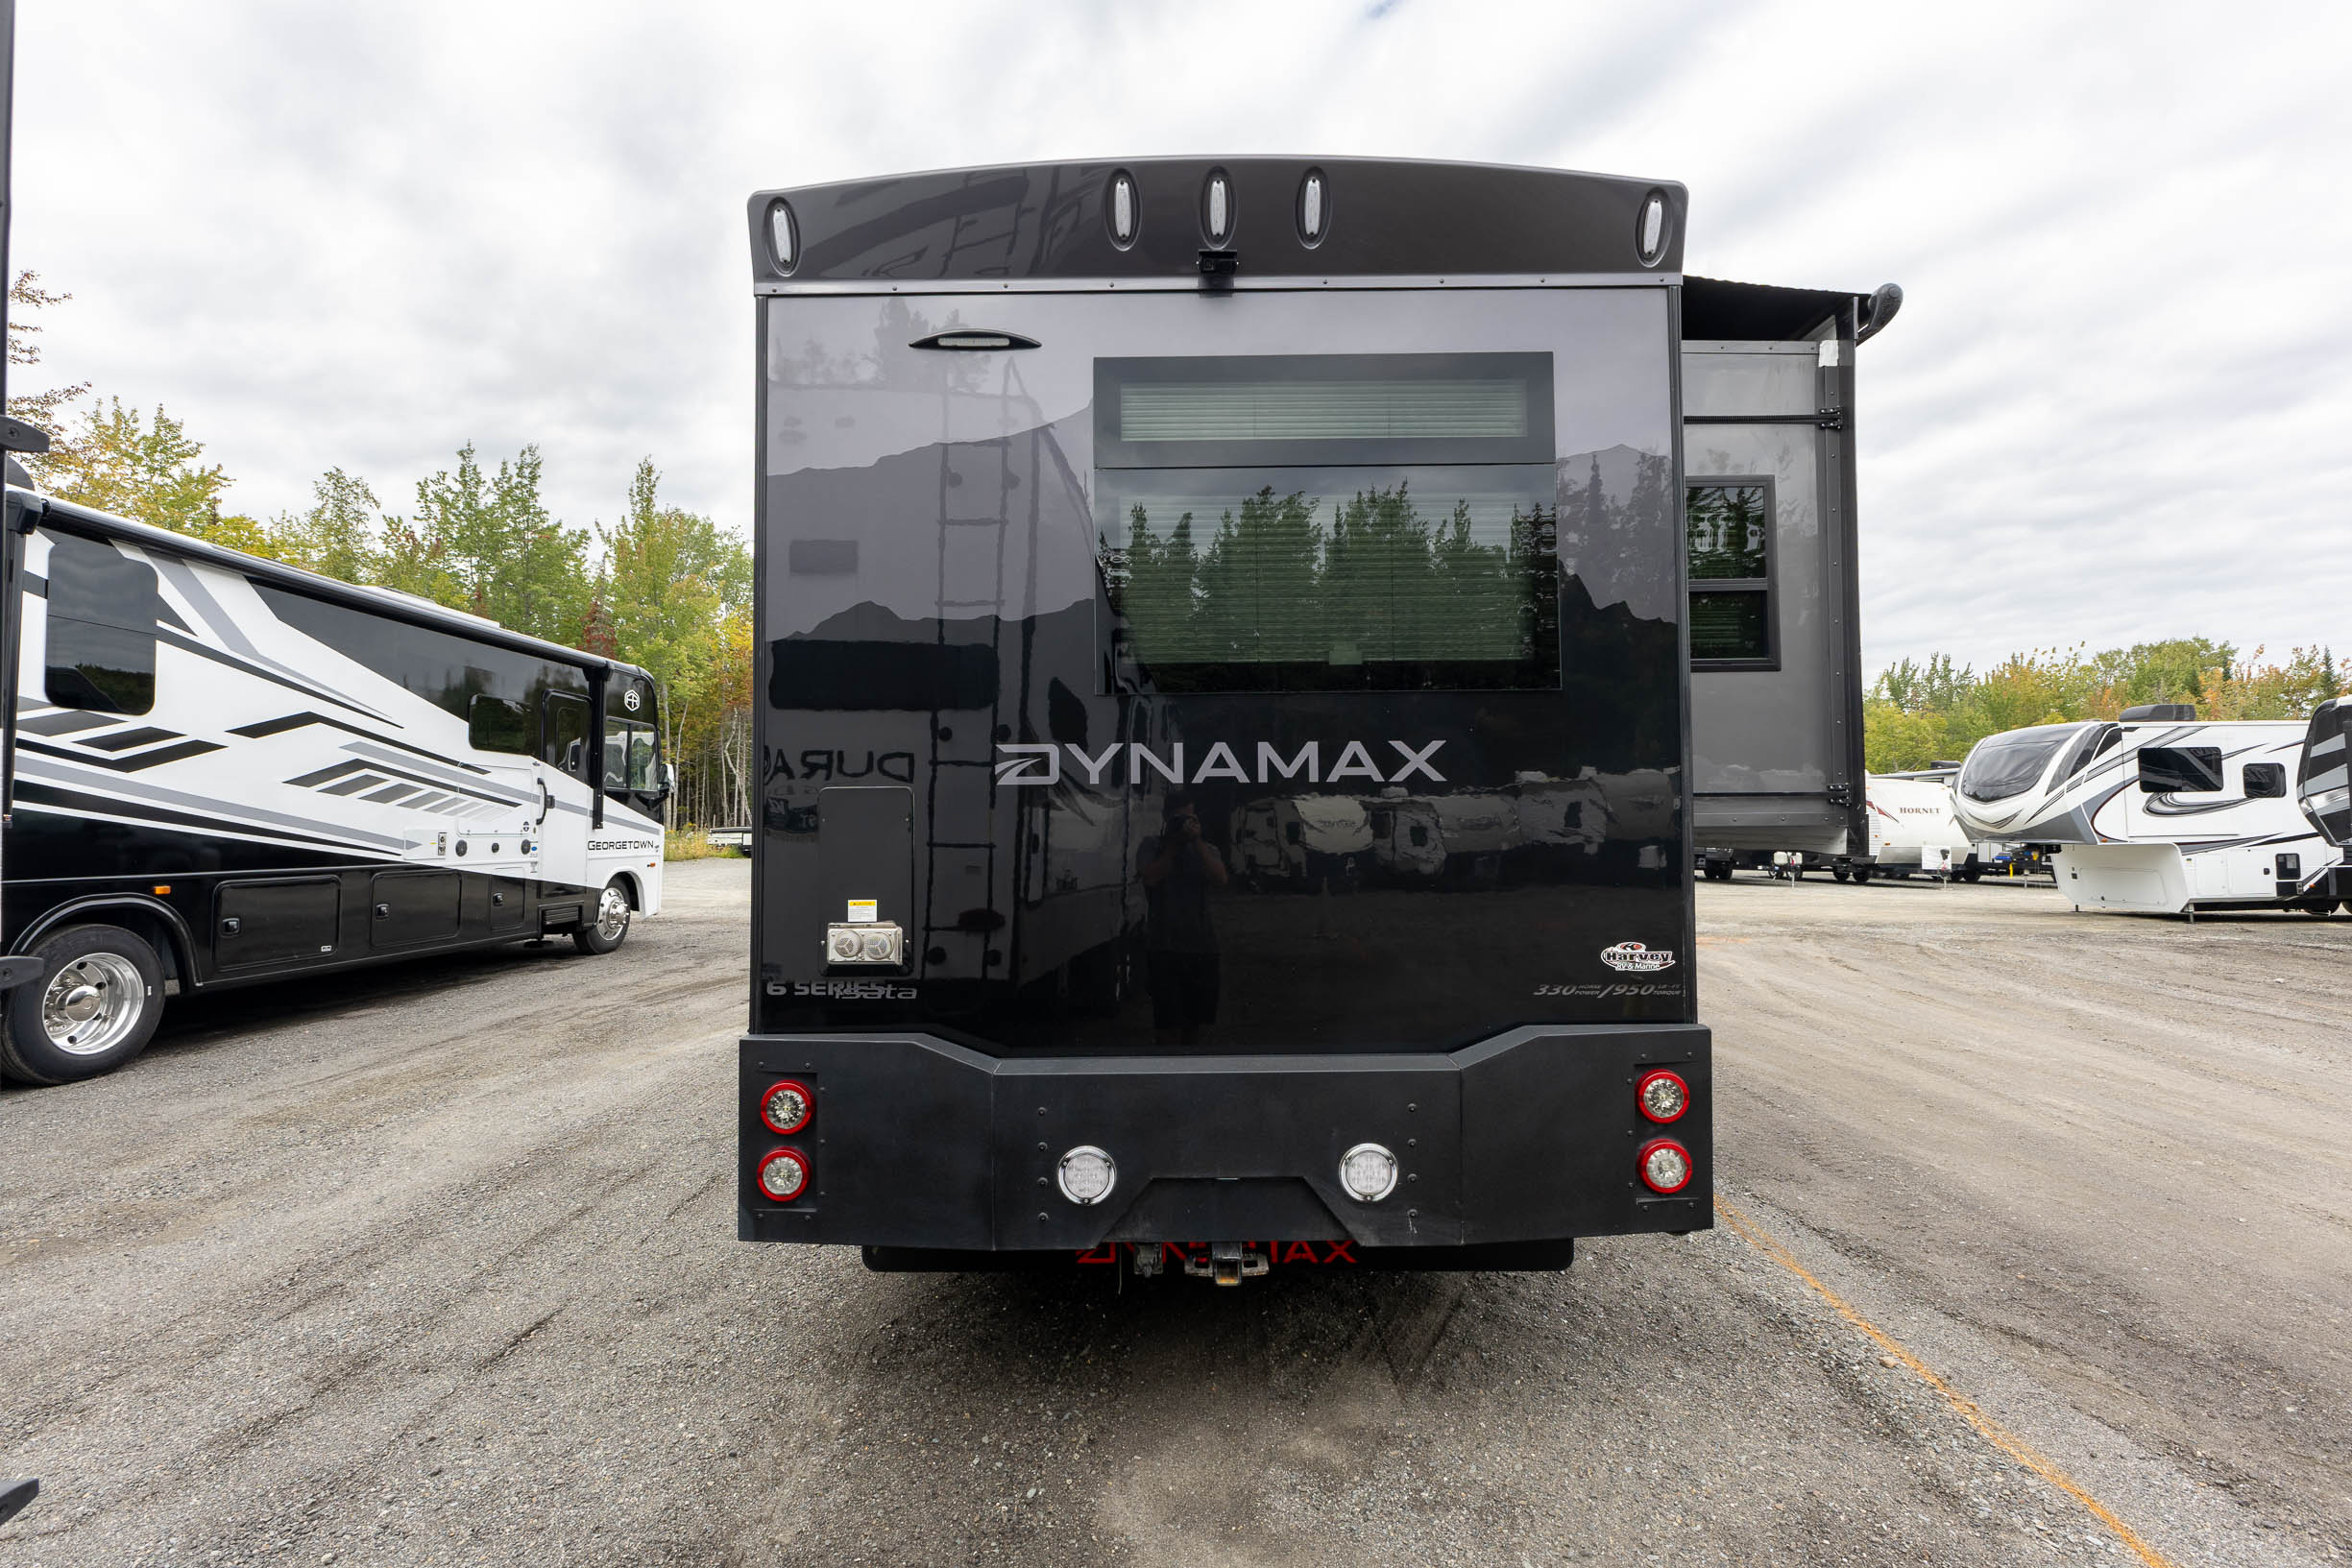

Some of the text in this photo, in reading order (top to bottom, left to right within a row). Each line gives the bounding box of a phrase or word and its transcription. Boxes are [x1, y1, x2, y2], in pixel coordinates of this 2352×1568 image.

[995, 740, 1447, 785] DYNAMAX
[588, 841, 653, 851] GEORGETOWN
[1606, 952, 1670, 962] Harvey
[766, 980, 787, 996] 6
[1534, 983, 1577, 996] 330
